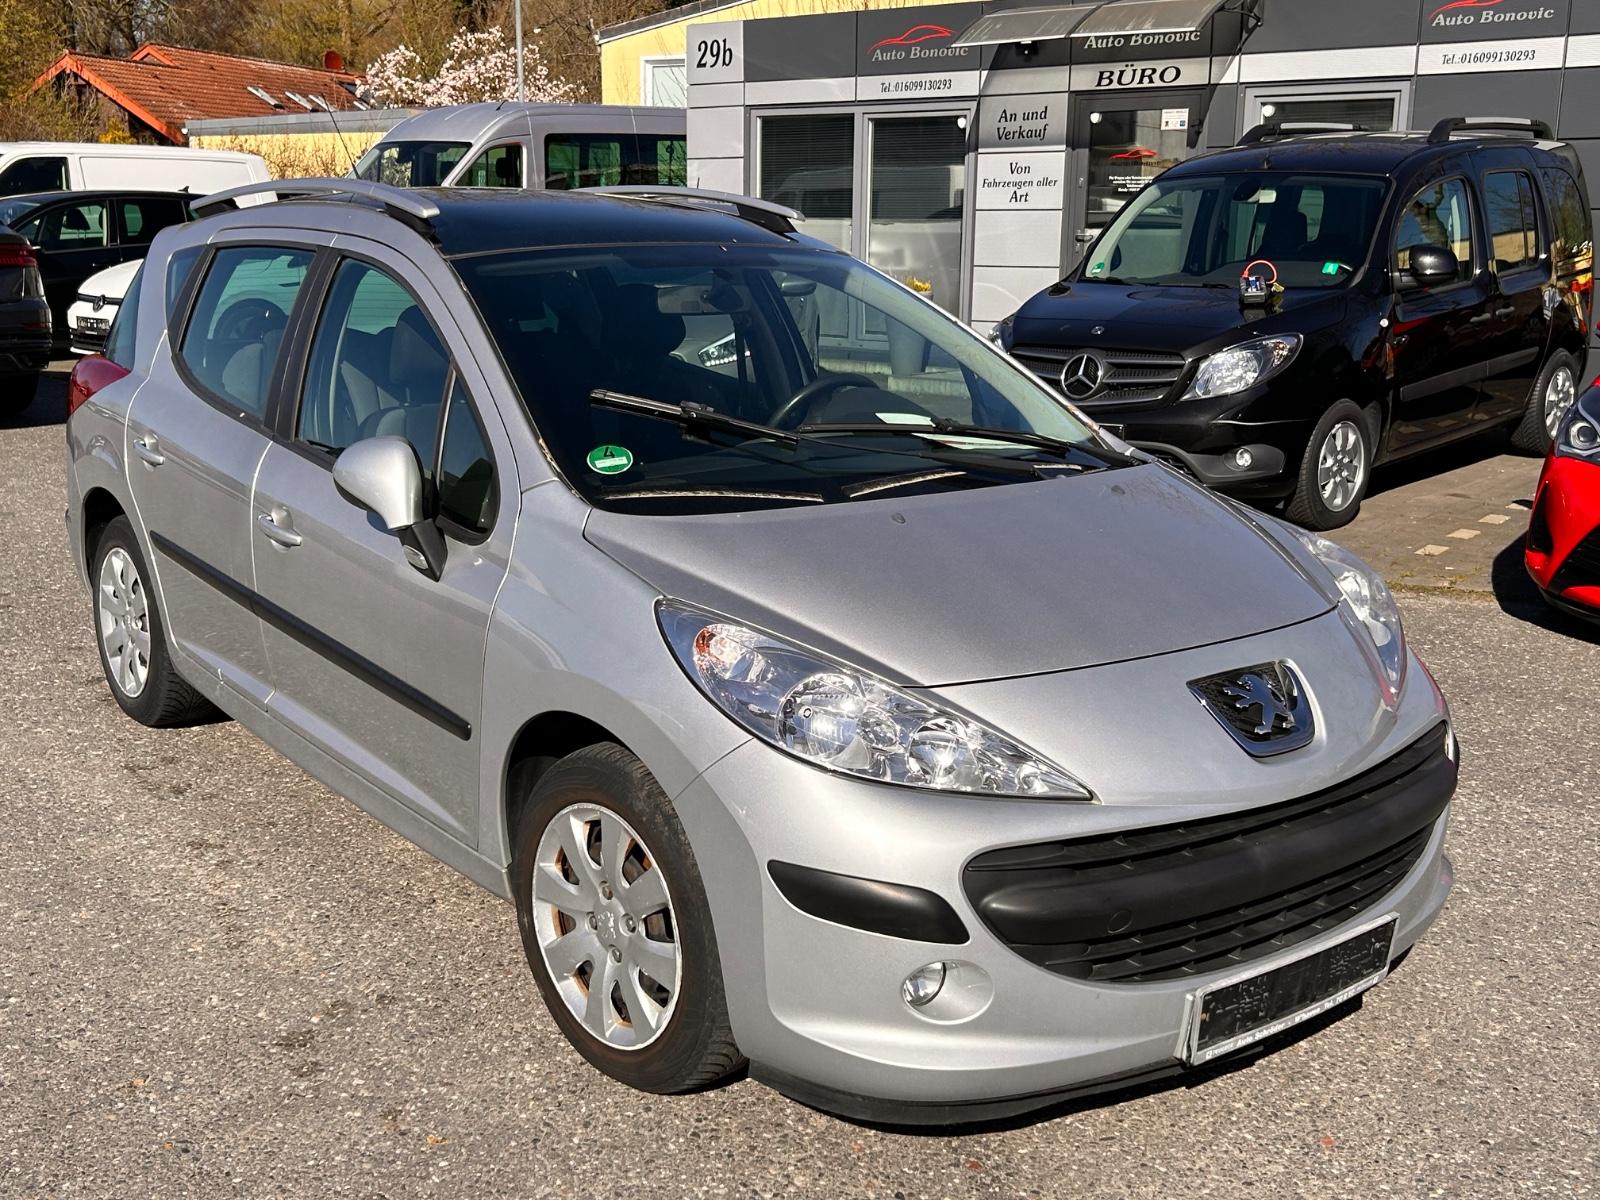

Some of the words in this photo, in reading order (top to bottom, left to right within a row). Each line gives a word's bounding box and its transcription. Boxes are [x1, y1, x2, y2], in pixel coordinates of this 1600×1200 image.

[1432, 14, 1473, 26] Auto
[1480, 8, 1554, 23] Bonovic
[1084, 34, 1124, 49] Auto
[1130, 31, 1201, 47] Bonovic
[696, 38, 733, 69] 29b
[871, 48, 905, 62] Auto
[910, 45, 969, 60] Bonovic
[1095, 64, 1182, 88] BÜRO
[998, 109, 1018, 123] An
[1022, 106, 1048, 121] und
[997, 125, 1049, 141] Verkauf
[1009, 162, 1031, 175] Von
[982, 178, 1034, 191] Fahrzeugen
[1036, 177, 1058, 188] aller
[1009, 190, 1030, 203] Art
[604, 447, 615, 458] 4
